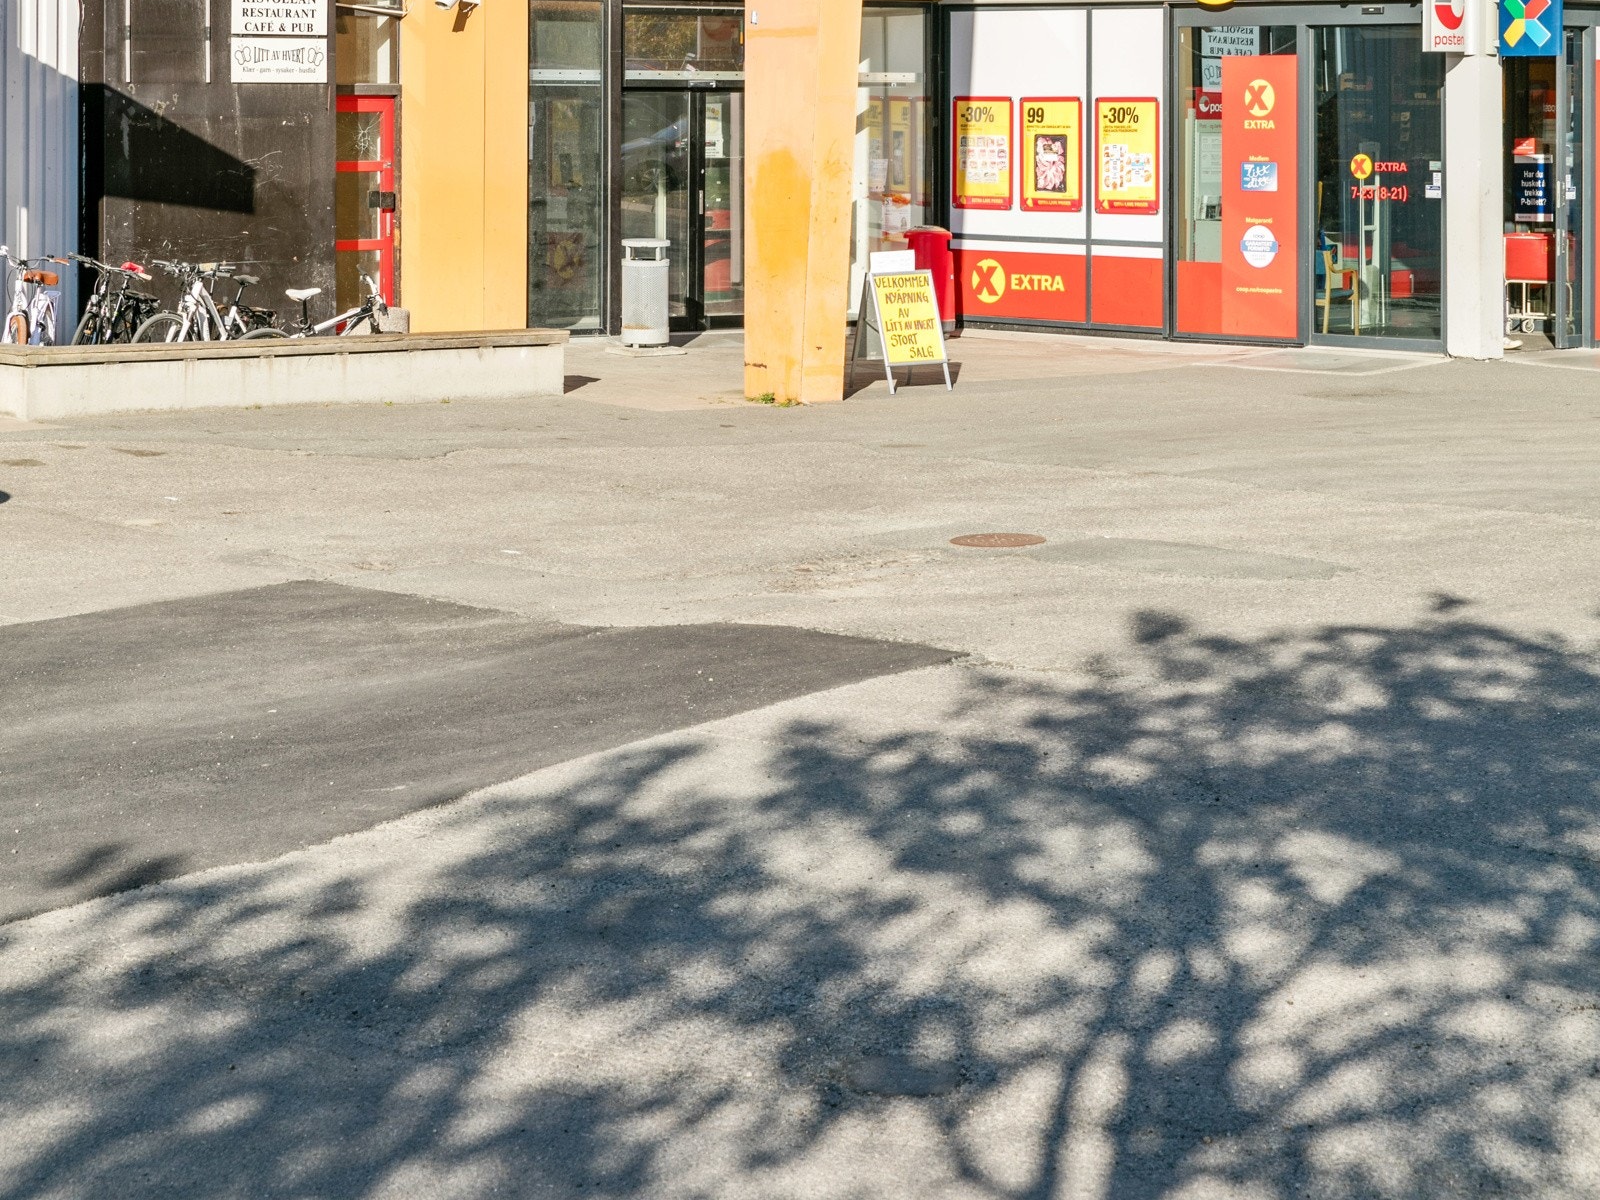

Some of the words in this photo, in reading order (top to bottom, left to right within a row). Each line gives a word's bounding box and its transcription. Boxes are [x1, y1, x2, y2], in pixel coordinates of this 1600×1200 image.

[242, 8, 317, 18] RESTAURANT
[244, 20, 274, 32] CAFÉ
[279, 22, 286, 32] &
[291, 22, 314, 32] PUB
[1434, 34, 1465, 47] posten
[253, 46, 270, 64] LITT
[271, 50, 280, 60] AV
[282, 47, 305, 64] HVERT
[961, 106, 994, 122] -30%
[1027, 107, 1044, 123] 99
[1103, 106, 1139, 123] -30%
[1210, 103, 1222, 114] pos
[1244, 120, 1276, 129] EXTRA
[1374, 162, 1408, 172] EXTRA
[1523, 170, 1534, 178] Har
[874, 276, 930, 289] VELKOMMEN
[1010, 274, 1065, 292] EXTRA
[885, 289, 929, 304] NYÅPNING
[898, 308, 910, 318] AV
[890, 333, 918, 348] STORT
[909, 345, 935, 359] SALG
